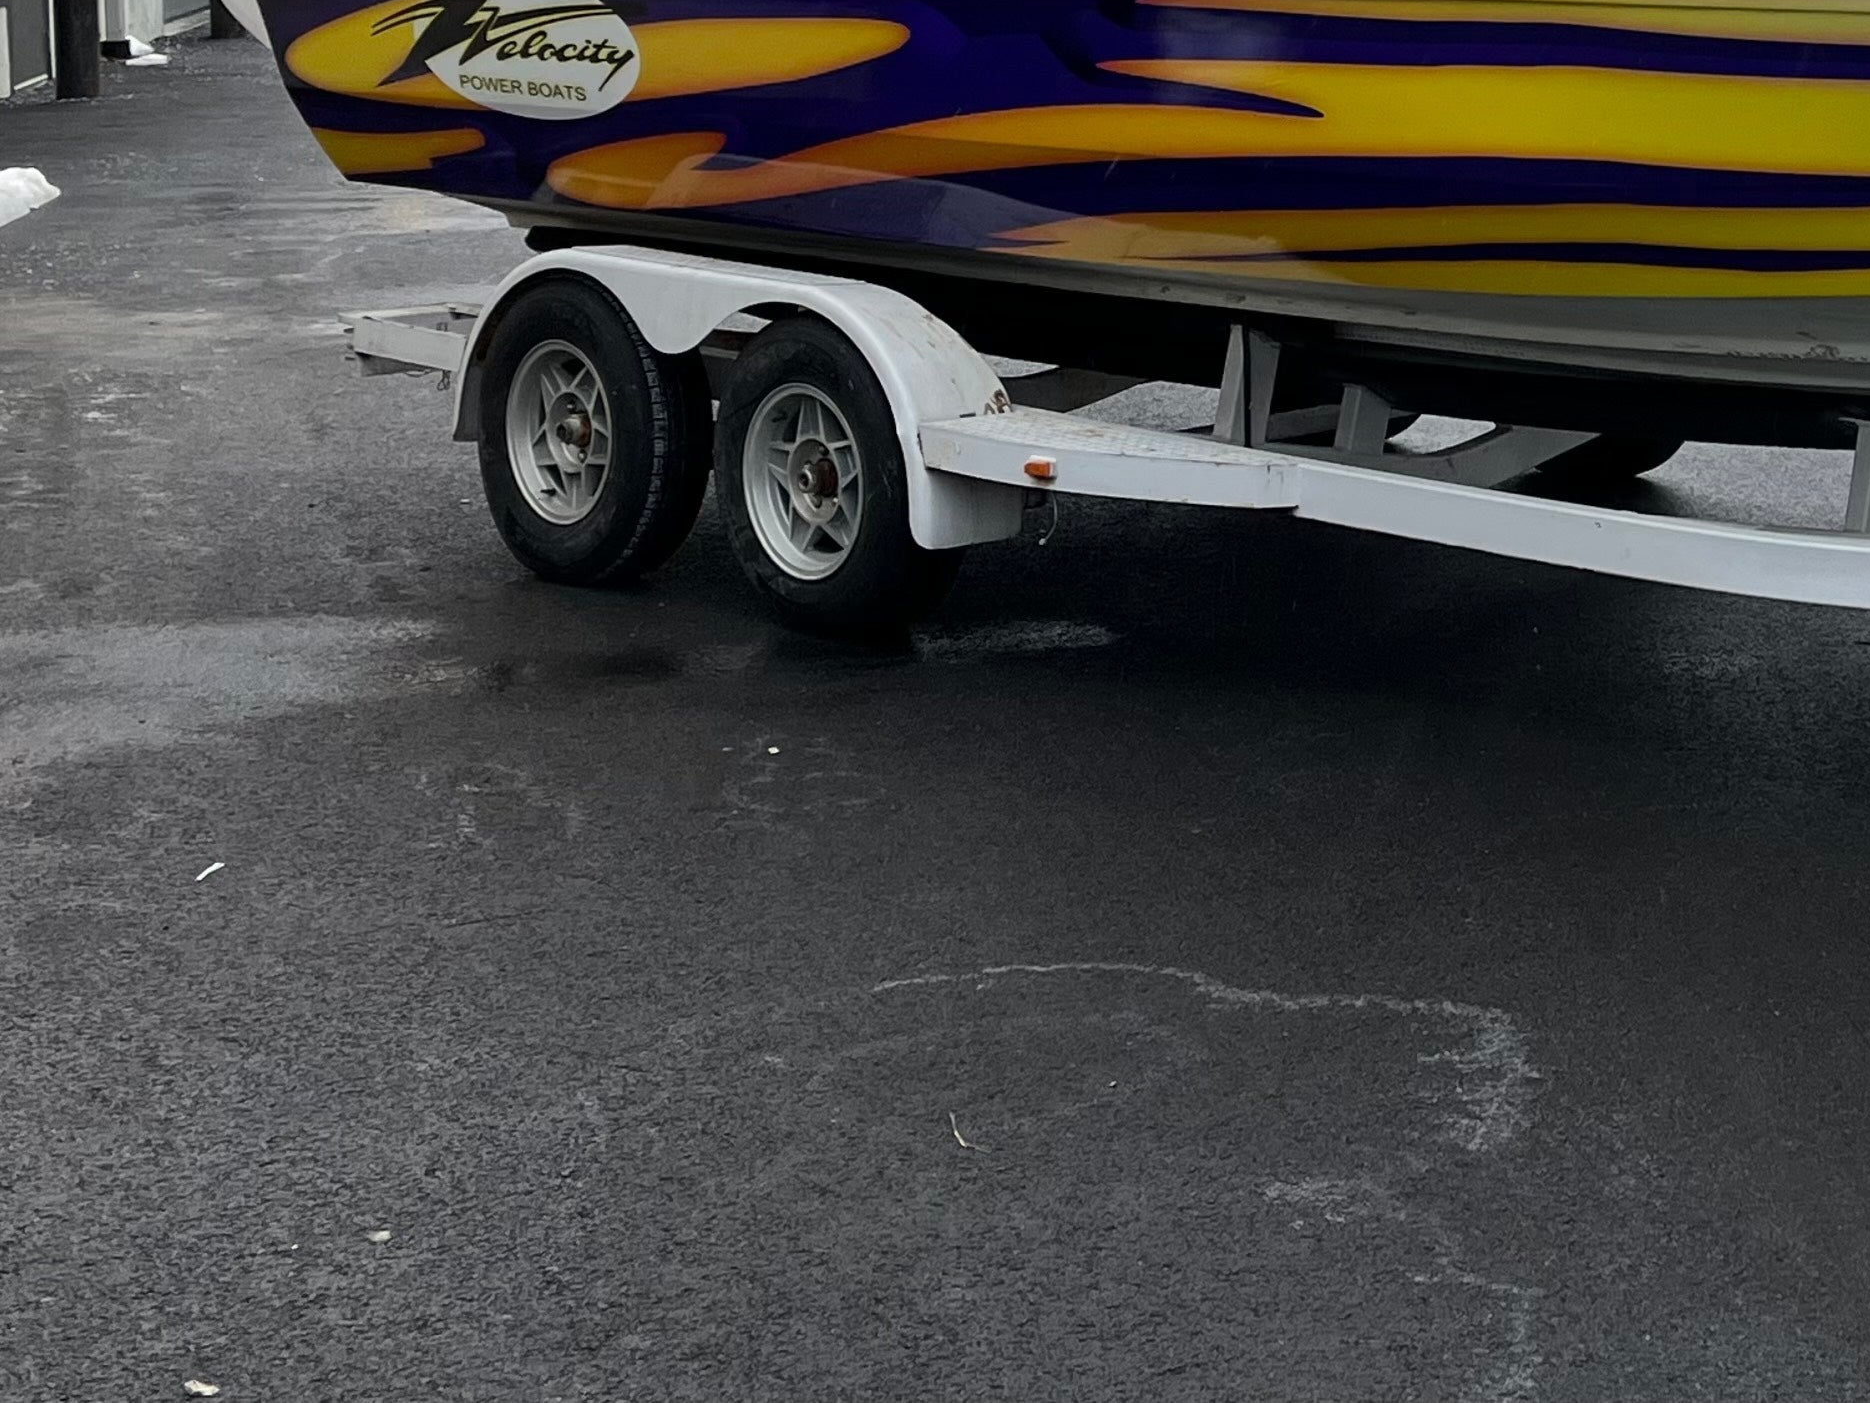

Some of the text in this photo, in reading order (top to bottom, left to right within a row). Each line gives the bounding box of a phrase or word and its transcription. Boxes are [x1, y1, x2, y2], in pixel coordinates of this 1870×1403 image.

[458, 5, 634, 91] Velocity
[459, 74, 587, 101] POWER BOATS
